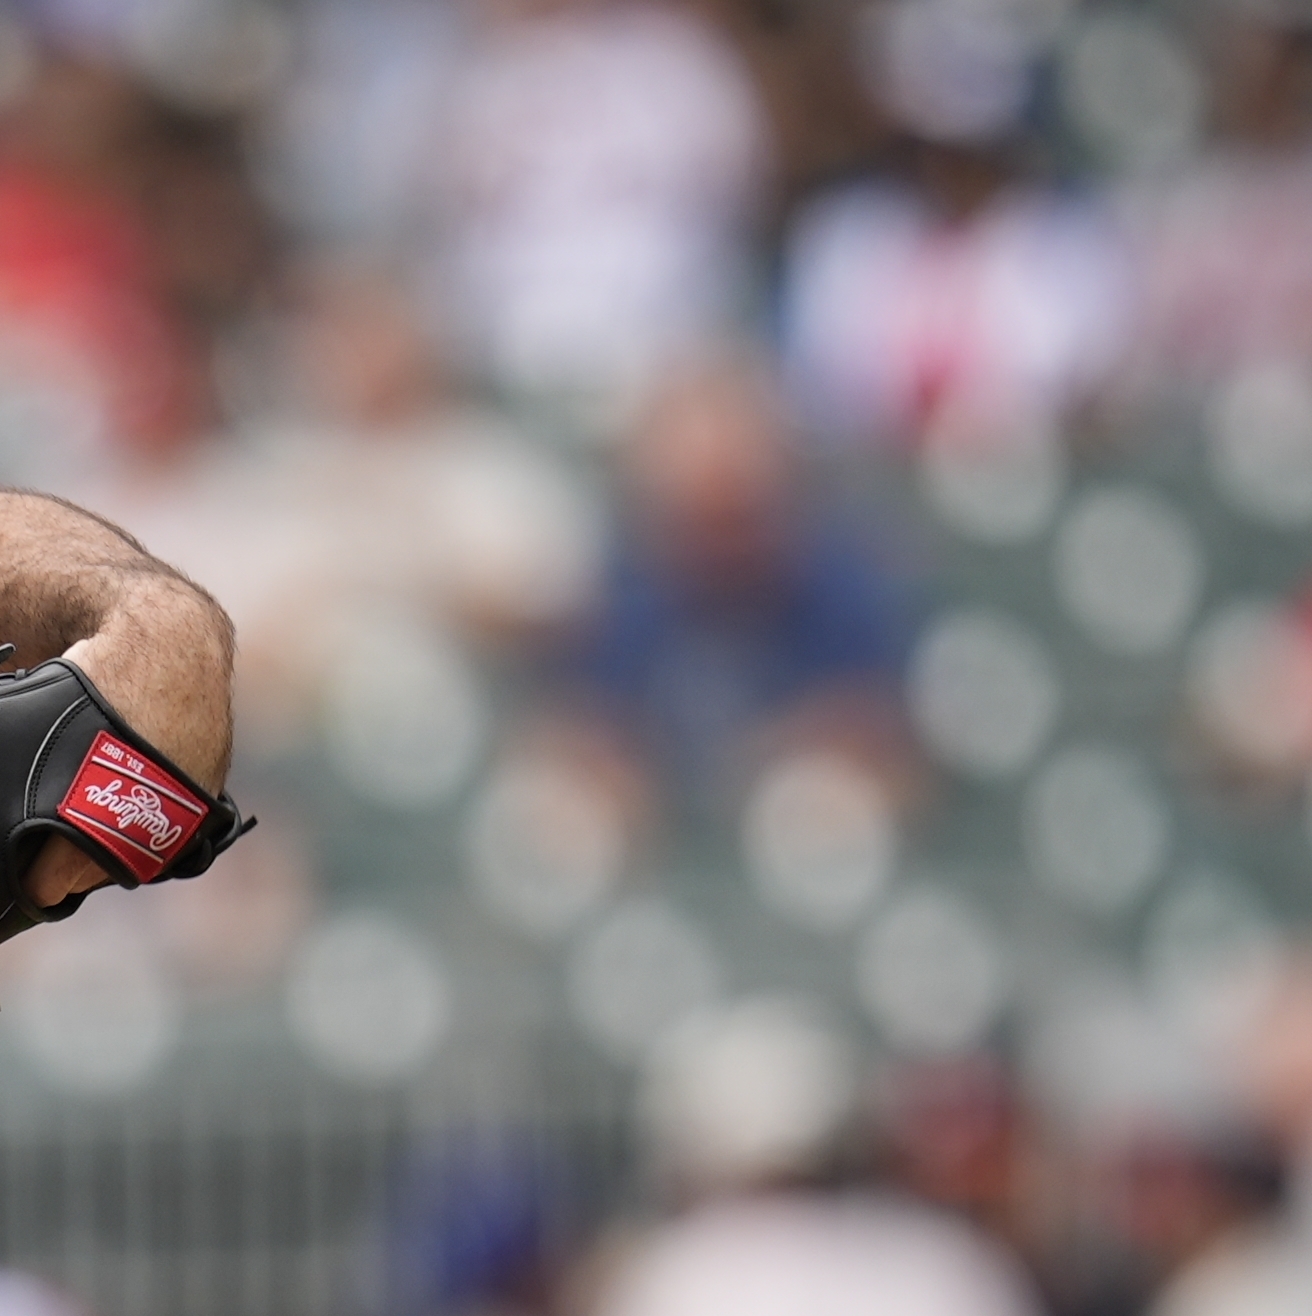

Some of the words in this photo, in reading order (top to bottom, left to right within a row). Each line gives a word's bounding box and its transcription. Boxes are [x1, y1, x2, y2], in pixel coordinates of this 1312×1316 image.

[100, 742, 124, 761] 1887
[126, 754, 145, 775] Est.
[84, 779, 183, 851] Rawlings
